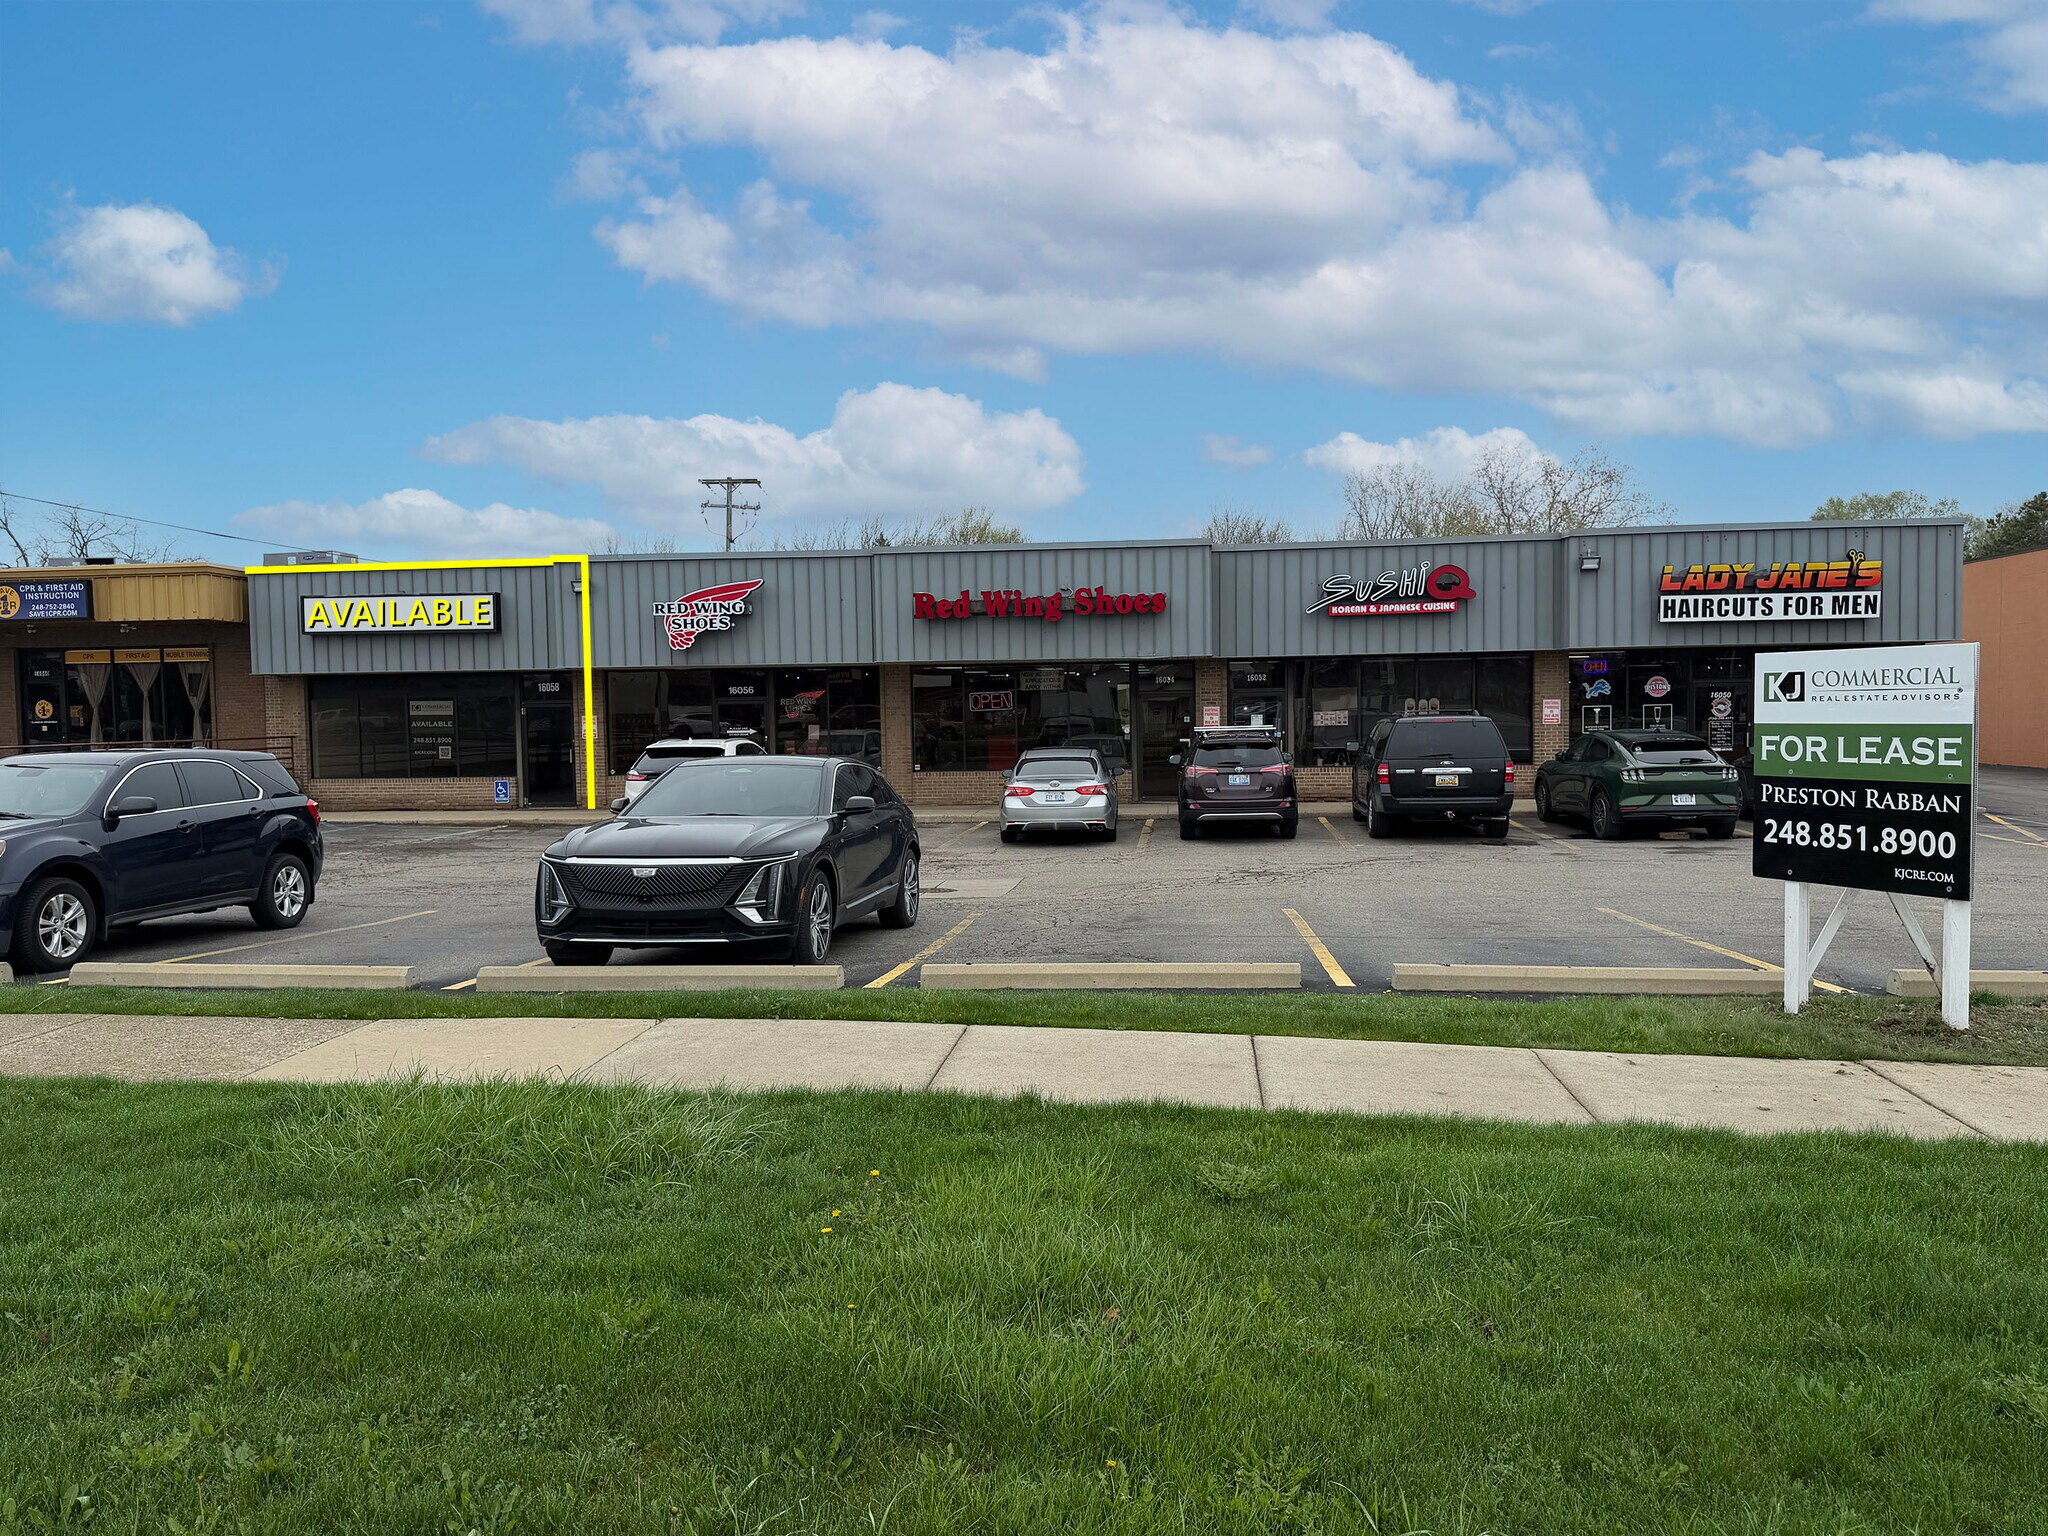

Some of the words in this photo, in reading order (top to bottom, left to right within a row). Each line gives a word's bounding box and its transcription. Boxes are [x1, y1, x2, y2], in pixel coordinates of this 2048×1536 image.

[1660, 563, 1754, 591] LADY
[45, 584, 68, 592] FIRST
[70, 583, 84, 591] AID
[25, 592, 80, 600] INSTRUCTION
[31, 603, 75, 611] 248-752-2840
[653, 602, 689, 615] RED
[693, 601, 745, 615] WING
[913, 589, 972, 620] Red
[981, 589, 1063, 622] Wing
[1073, 586, 1167, 616] Shoes
[1332, 605, 1367, 614] KOREAN
[1379, 603, 1421, 612] JAPANESE
[1423, 602, 1456, 610] CUISINE
[1663, 596, 1774, 619] HAIRCUTS
[1783, 595, 1824, 616] FOR
[1831, 594, 1878, 615] MEN
[28, 610, 78, 618] SAVE1CPR.COM
[671, 617, 730, 630] SHOES
[1584, 662, 1607, 672] OPEN
[1811, 666, 1960, 688] COMMERCIAL
[538, 682, 560, 692] 16058
[728, 686, 754, 694] 16056
[1765, 672, 1804, 702] KJ
[780, 698, 795, 706] RED
[795, 697, 816, 705] WING
[971, 693, 1011, 710] OPEN
[1844, 694, 1888, 702] ESTATE
[1891, 693, 1960, 701] ADVISORS
[1760, 735, 1829, 763] FOR
[1837, 736, 1963, 767] LEASE
[1763, 818, 1957, 859] 248.851.8900
[1894, 868, 1955, 884] KJCRE.COM
